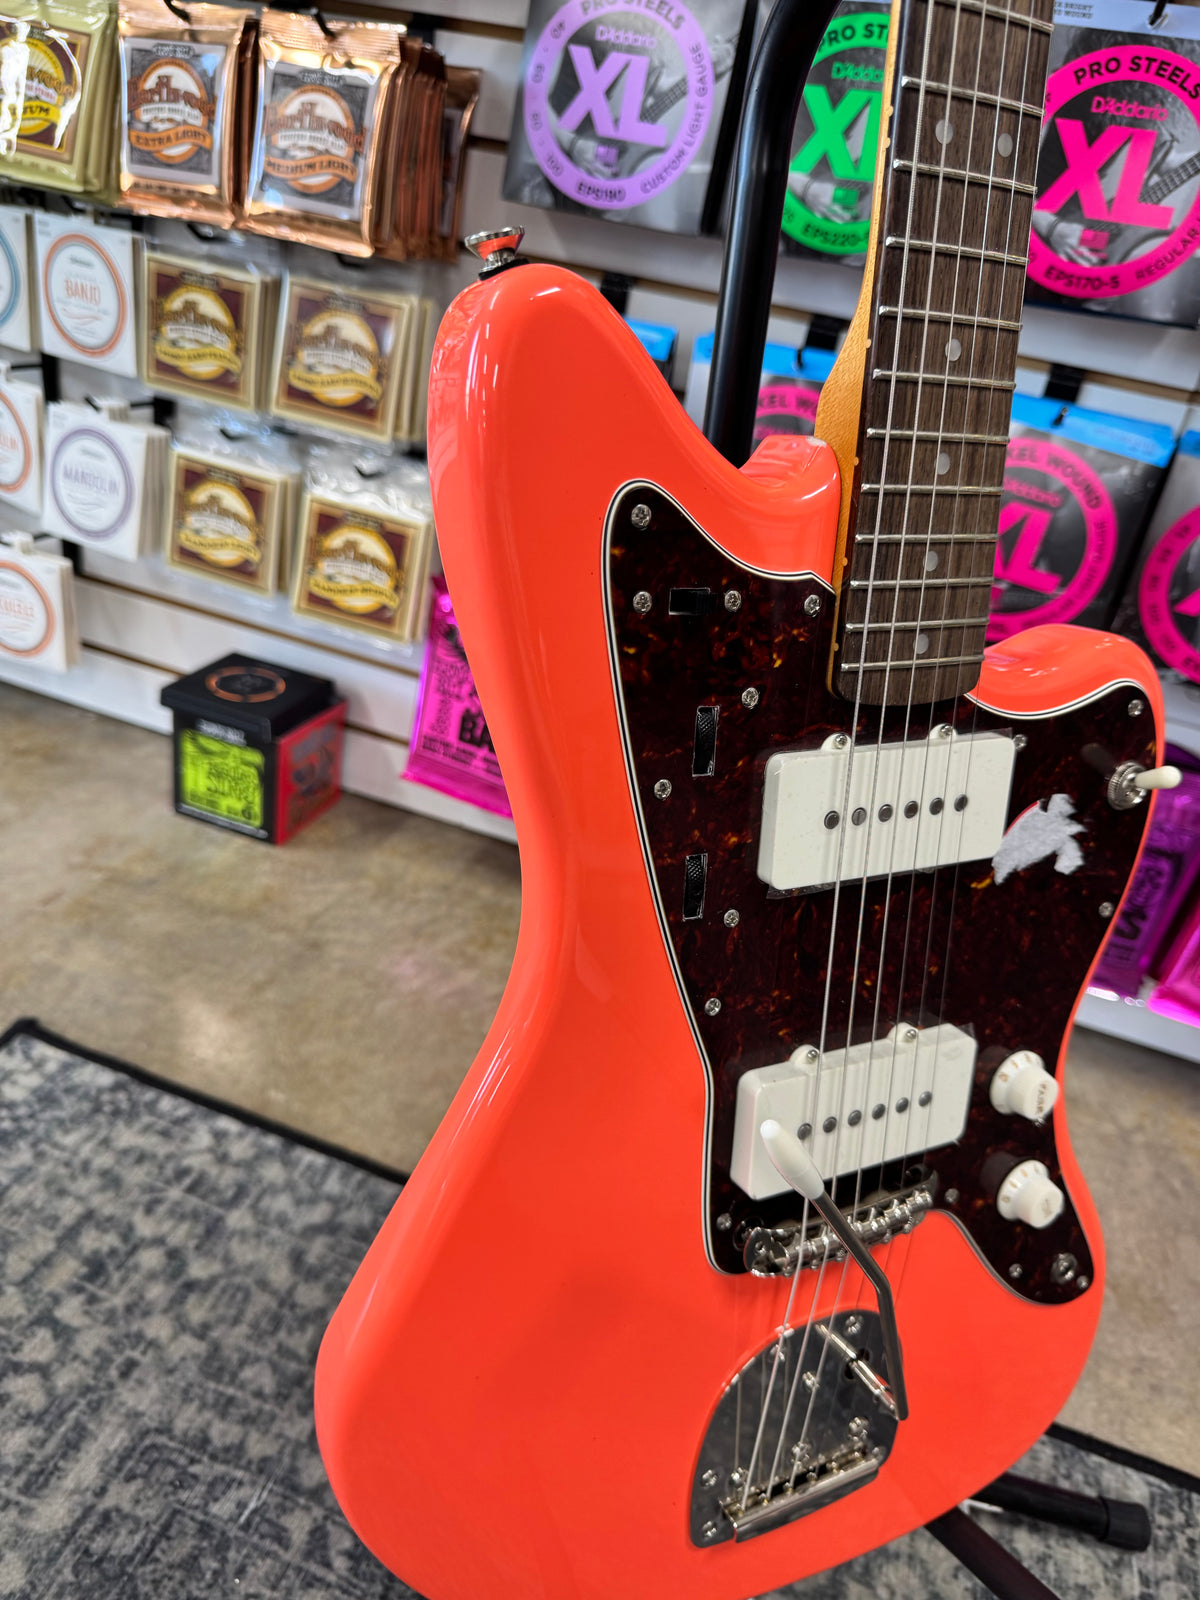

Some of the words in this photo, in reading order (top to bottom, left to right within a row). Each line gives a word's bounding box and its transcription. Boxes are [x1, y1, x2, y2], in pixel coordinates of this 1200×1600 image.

[557, 44, 668, 147] XL
[1073, 57, 1121, 85] PRO
[1128, 56, 1200, 99] STEELS
[1090, 95, 1169, 122] D'Addario
[1033, 117, 1175, 230] XL
[1134, 227, 1200, 281] REGULAR
[64, 276, 102, 306] BANJO
[1043, 265, 1121, 291] EPS170-5
